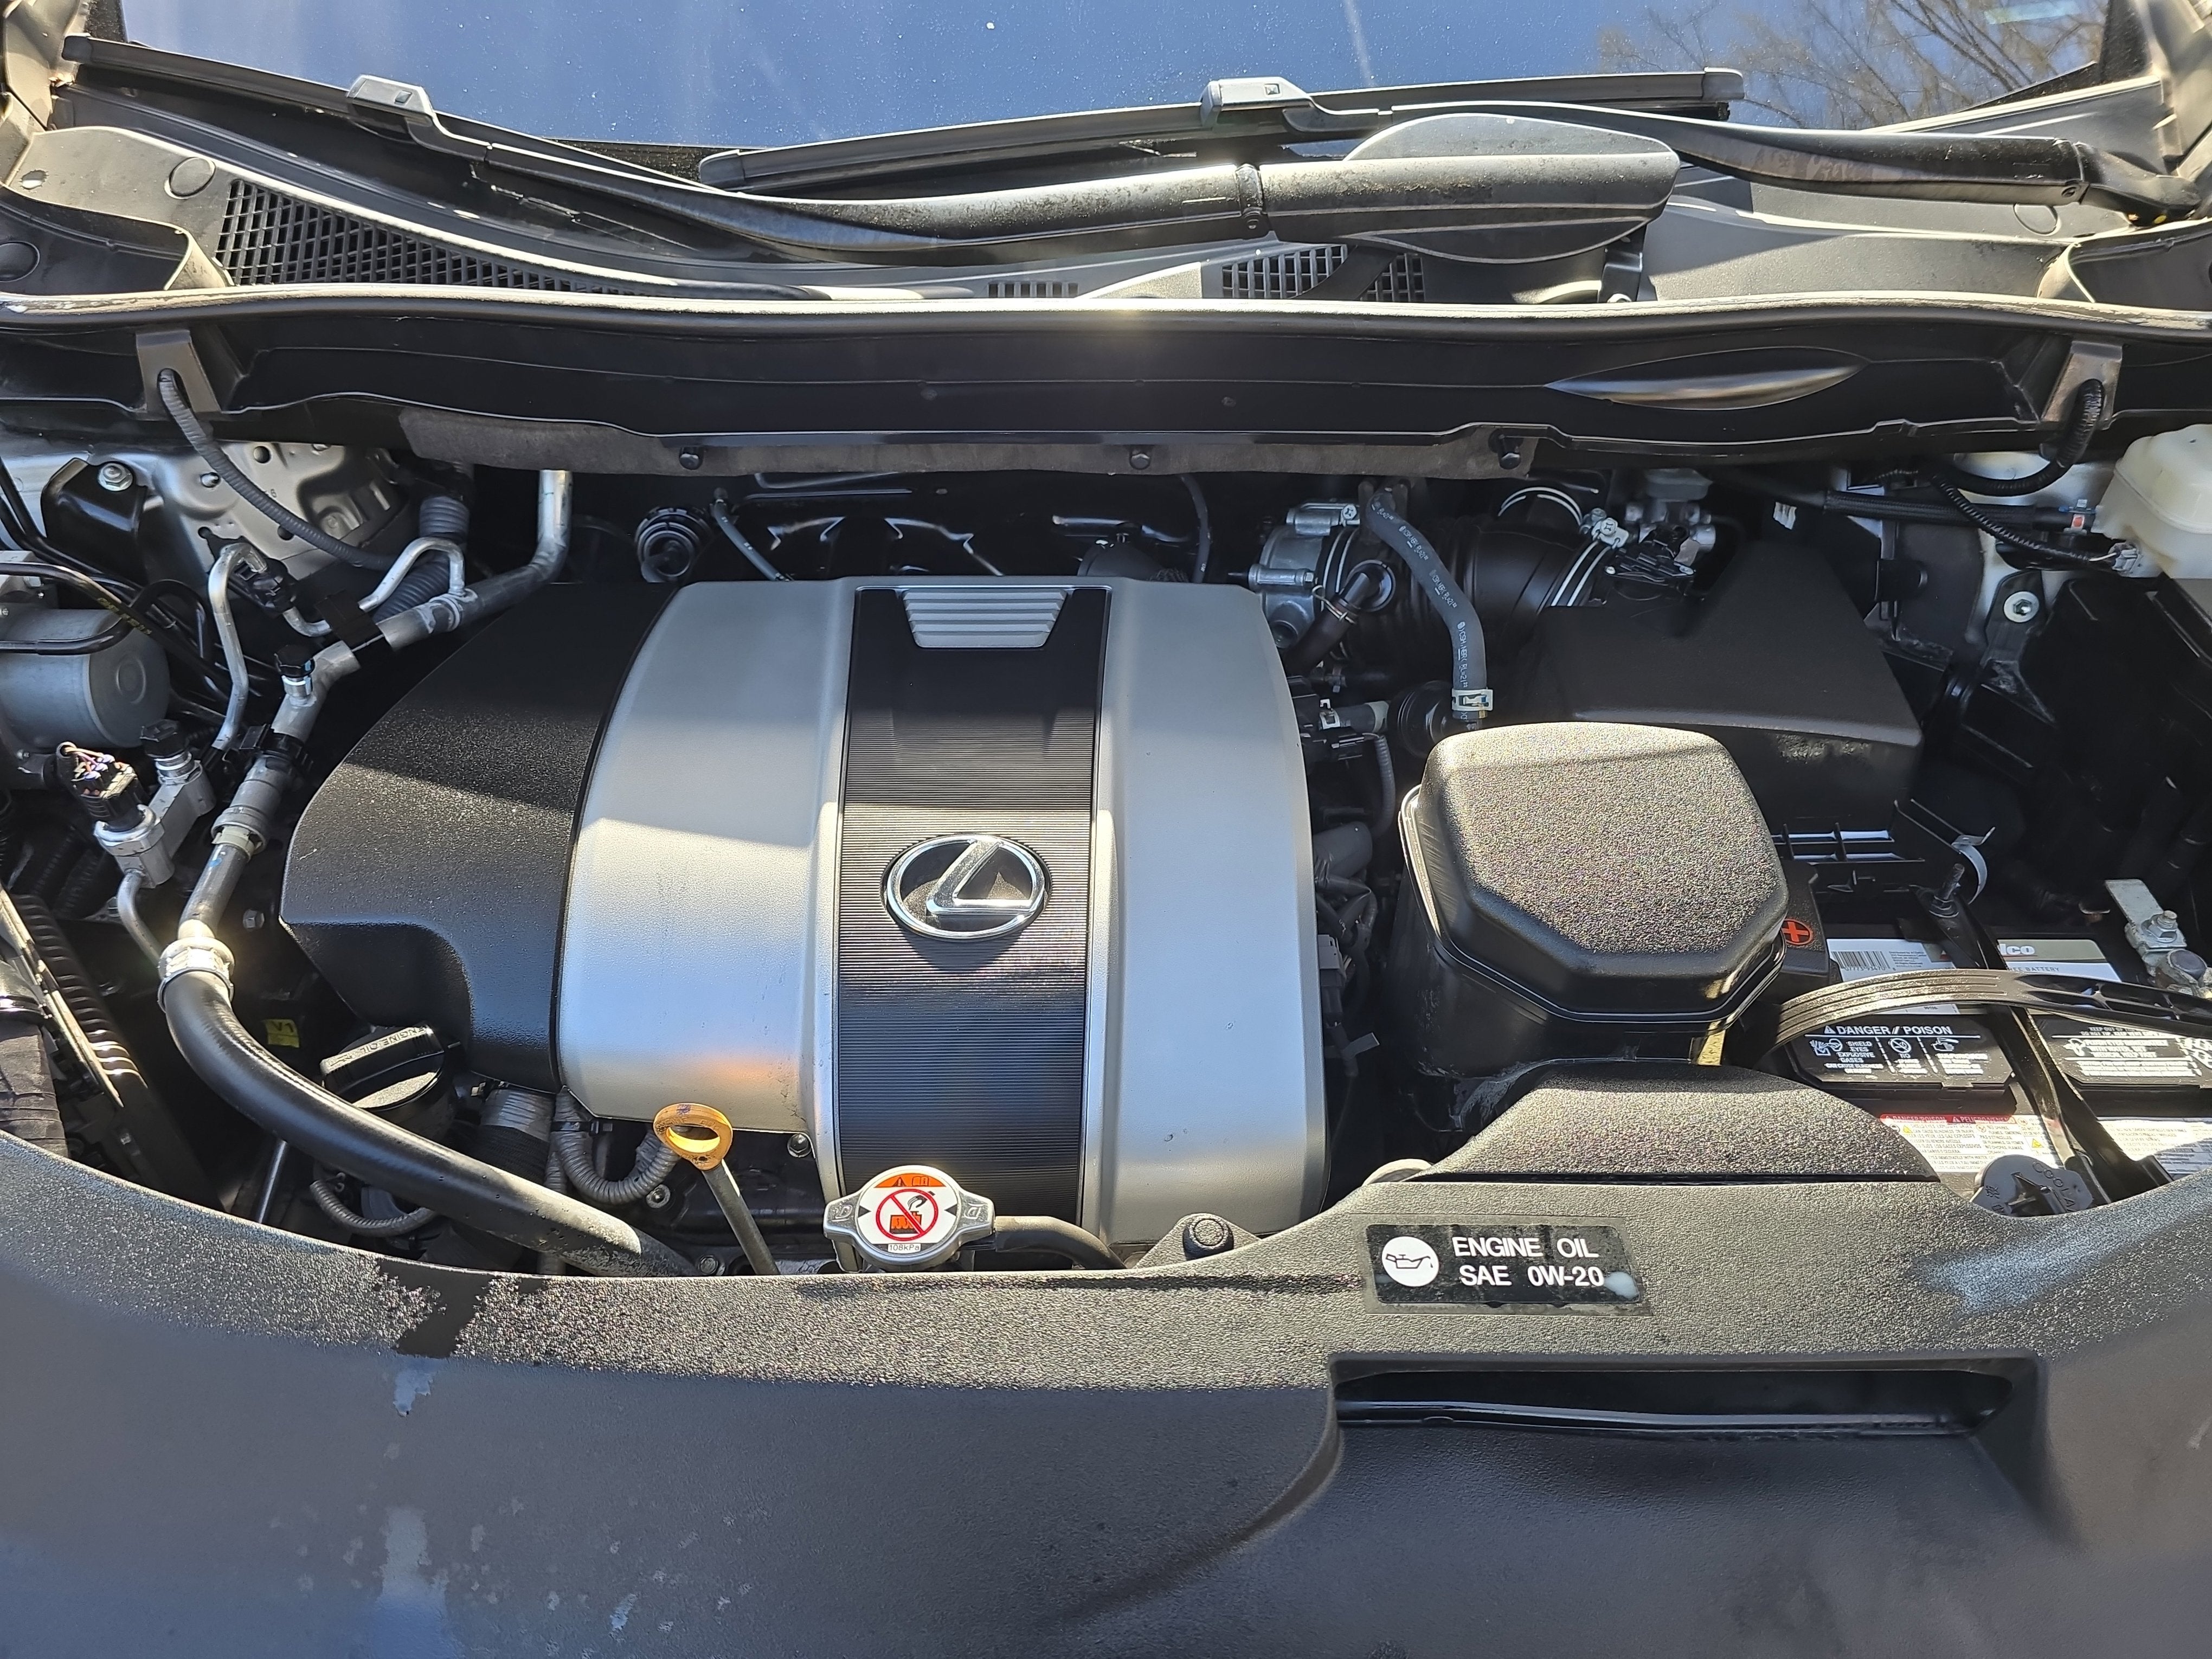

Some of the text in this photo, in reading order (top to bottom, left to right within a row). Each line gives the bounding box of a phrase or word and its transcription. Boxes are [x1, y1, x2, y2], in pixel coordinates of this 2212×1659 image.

[1836, 1026, 1891, 1034] DANGER
[1902, 1026, 1953, 1034] POISON
[889, 1244, 921, 1252] 108kPa
[1451, 1237, 1599, 1258] ENGINE OIL
[1459, 1265, 1604, 1287] SAE 0W-20
